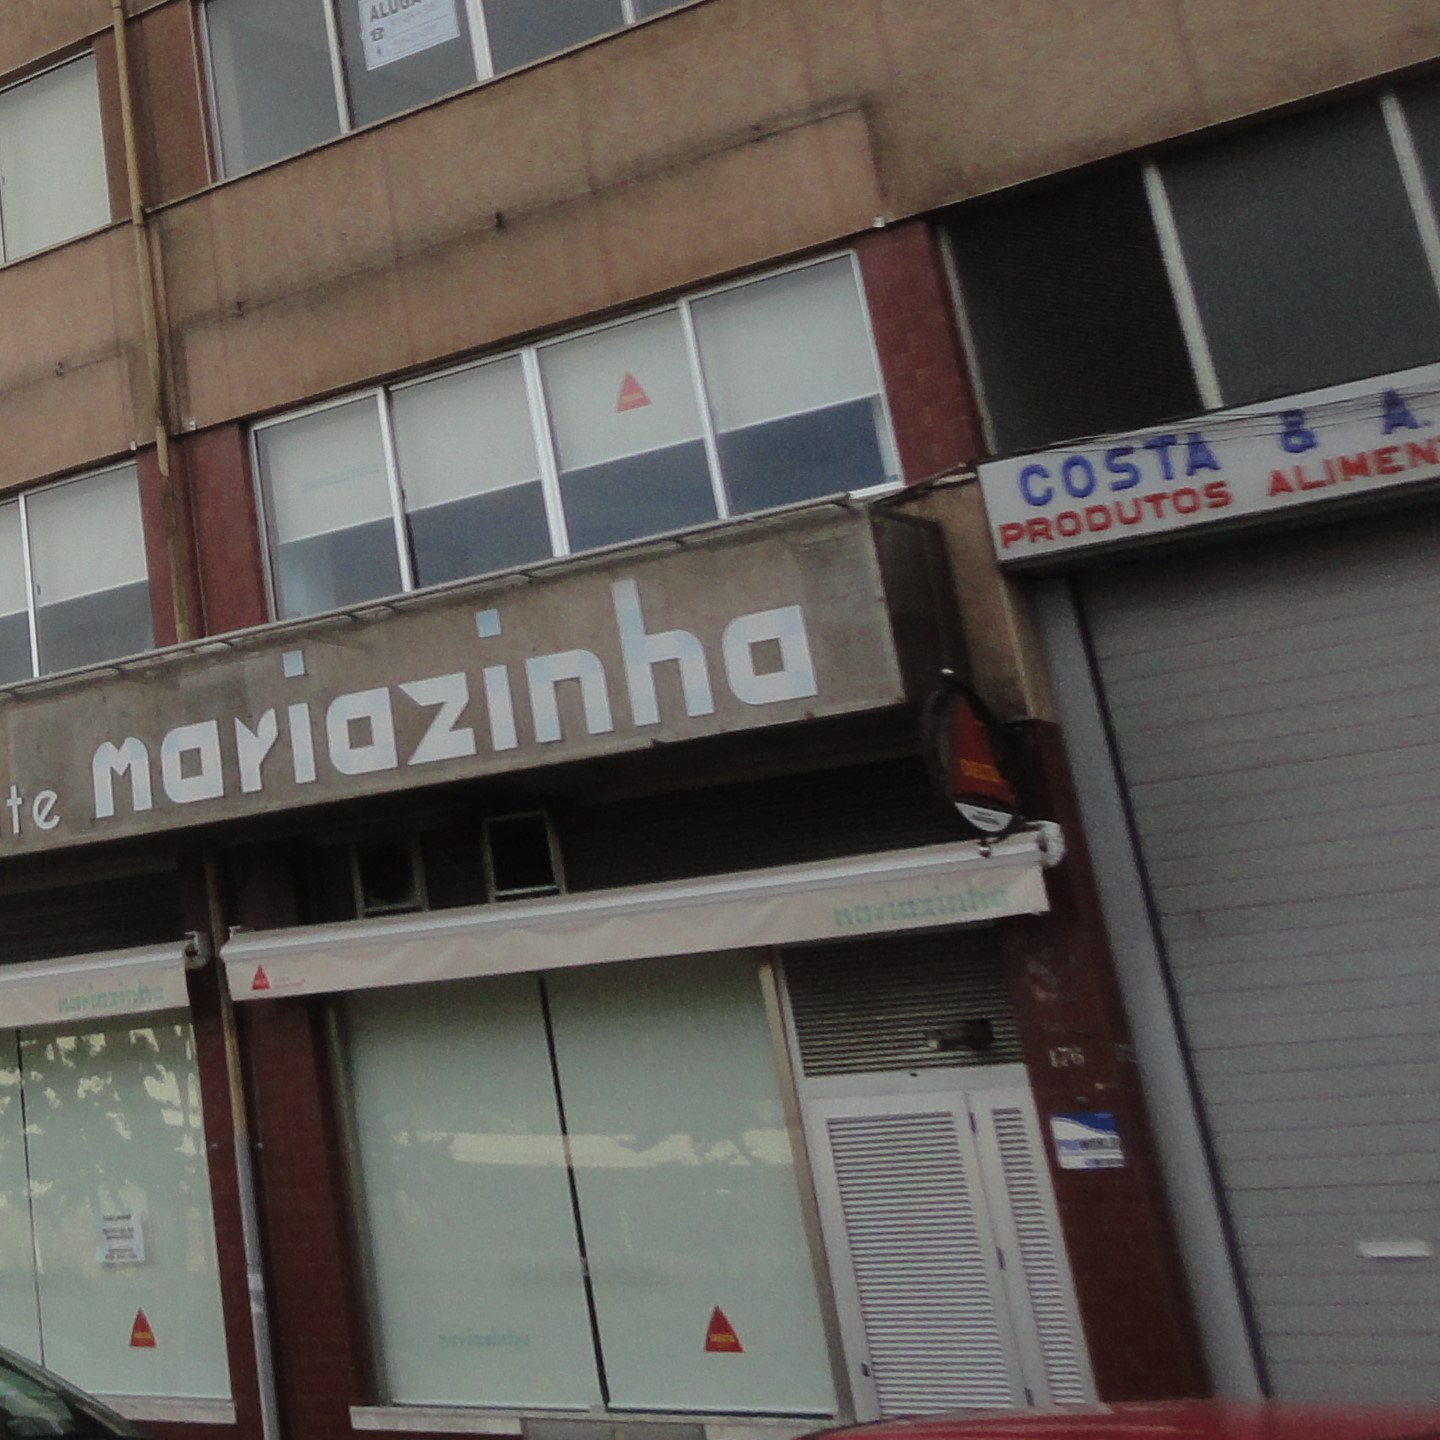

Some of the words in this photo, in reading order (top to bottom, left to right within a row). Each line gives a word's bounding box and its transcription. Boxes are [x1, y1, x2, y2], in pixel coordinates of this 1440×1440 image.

[1018, 431, 1221, 508] COSTA
[1279, 408, 1317, 454] &
[998, 480, 1233, 549] PRODUTOS
[91, 578, 819, 820] mariazinha
